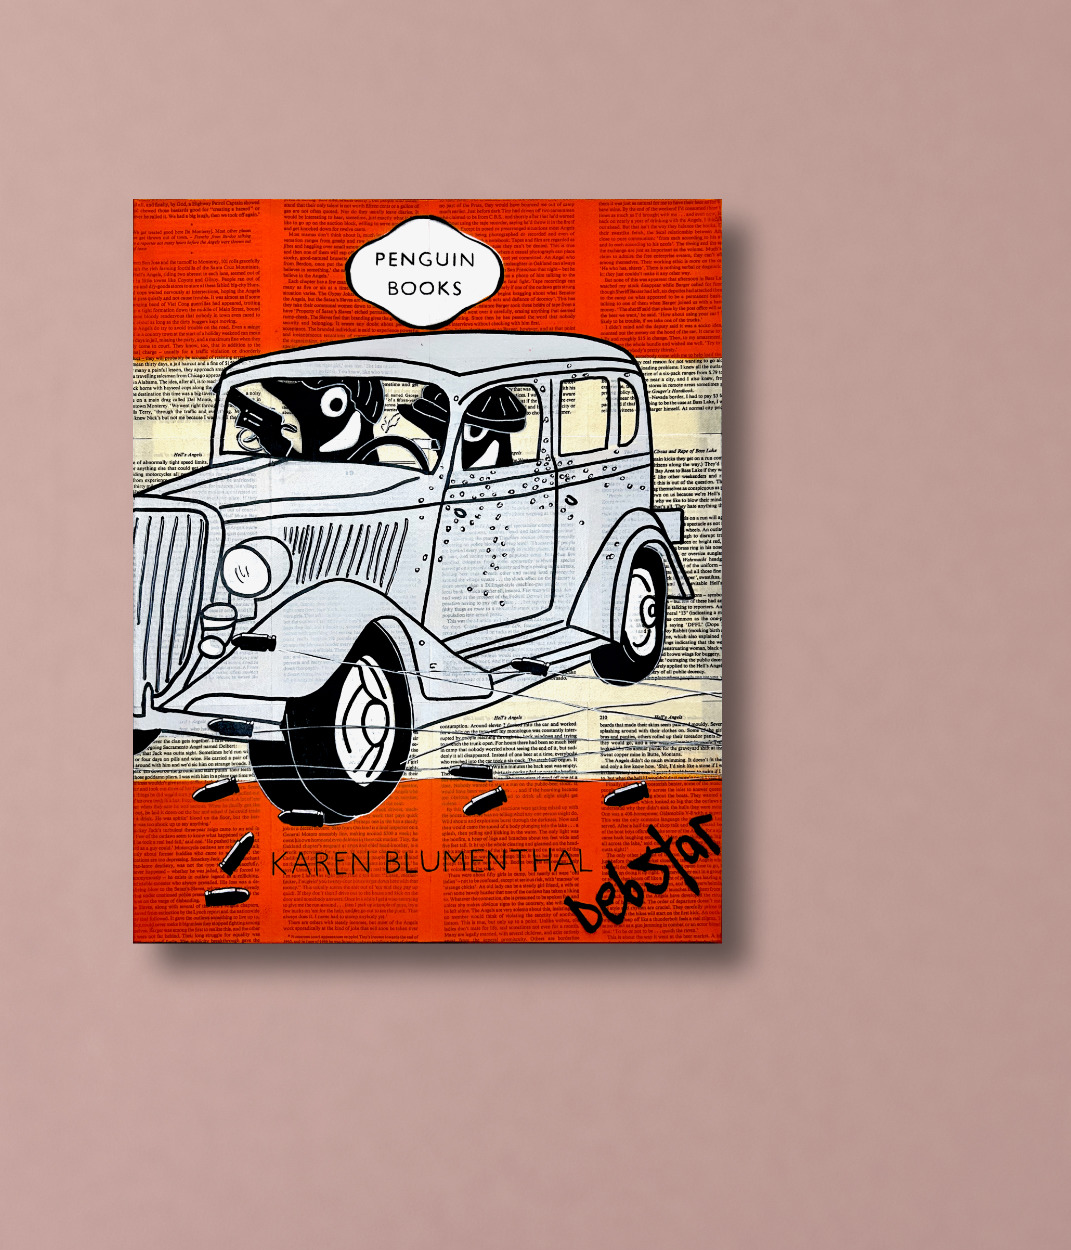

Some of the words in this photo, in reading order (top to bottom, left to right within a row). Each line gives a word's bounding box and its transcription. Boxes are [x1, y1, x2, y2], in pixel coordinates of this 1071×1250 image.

[375, 252, 474, 267] PENGUIN
[388, 281, 462, 296] BOOKS
[272, 851, 370, 876] KAREN
[386, 848, 593, 874] BLUMENTHAL
